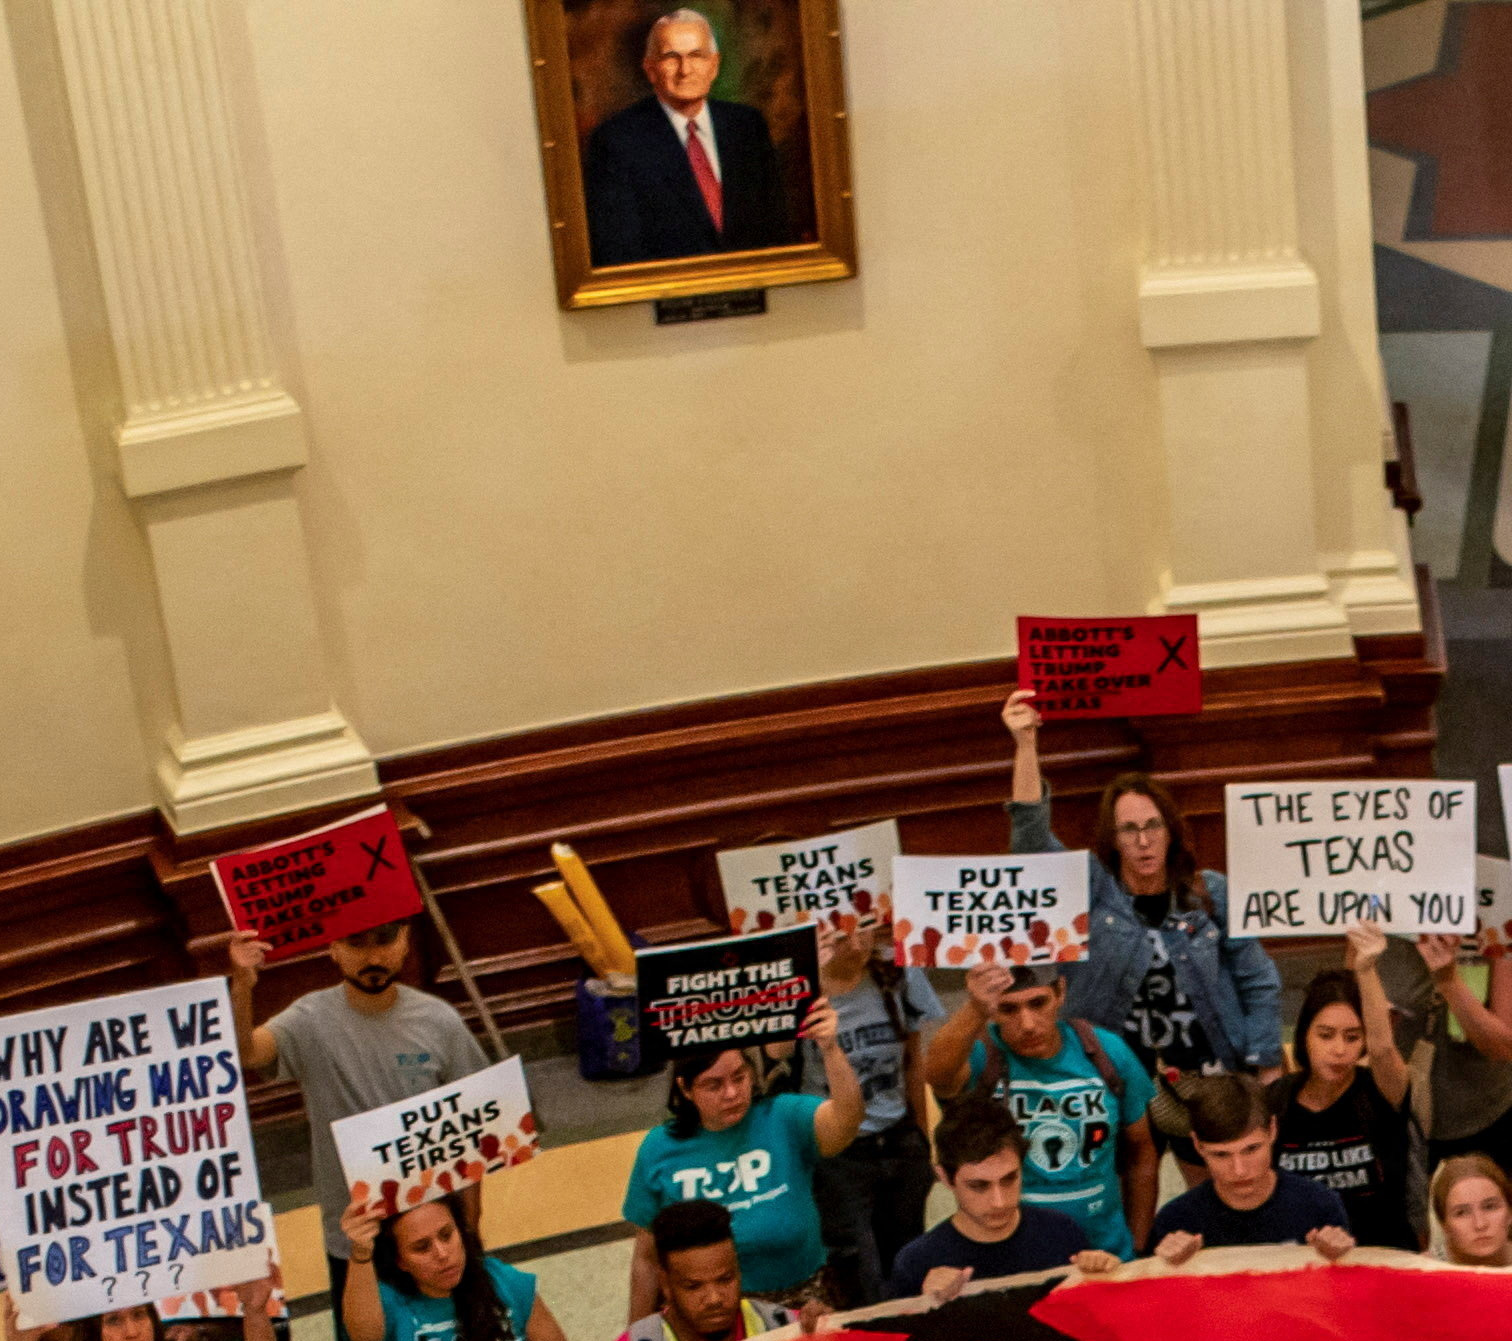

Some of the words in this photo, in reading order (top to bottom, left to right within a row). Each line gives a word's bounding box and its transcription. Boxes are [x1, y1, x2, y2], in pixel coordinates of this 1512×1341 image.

[1243, 791, 1312, 826] THE
[1332, 786, 1409, 821] EYES
[1429, 785, 1464, 819] OF
[753, 858, 874, 895] TEXANS
[781, 846, 838, 873] PUT
[1287, 833, 1414, 878] TEXAS
[960, 867, 1024, 887] PUT
[777, 884, 859, 914] FIRST
[925, 887, 1058, 911] TEXANS
[1242, 890, 1303, 930] ARE
[1319, 886, 1393, 926] UPON
[1409, 888, 1464, 924] YOU
[947, 911, 1036, 933] FIRST
[667, 968, 743, 995] FIGHT
[745, 958, 793, 981] THE
[651, 982, 811, 1031] TRUMP
[84, 1013, 150, 1062] ARE
[168, 999, 223, 1046] WE
[667, 1014, 796, 1046] TAKEOVER
[149, 1050, 238, 1106] MAPS
[372, 1100, 500, 1164] TEXANS
[400, 1092, 463, 1133] PUT
[13, 1130, 95, 1188] FOR
[107, 1102, 237, 1168] TRUMP
[400, 1130, 484, 1180] FIRST
[25, 1169, 183, 1235] INSTEAD
[196, 1152, 244, 1200] OF
[17, 1239, 97, 1293] FOR
[102, 1199, 266, 1276] TEXANS
